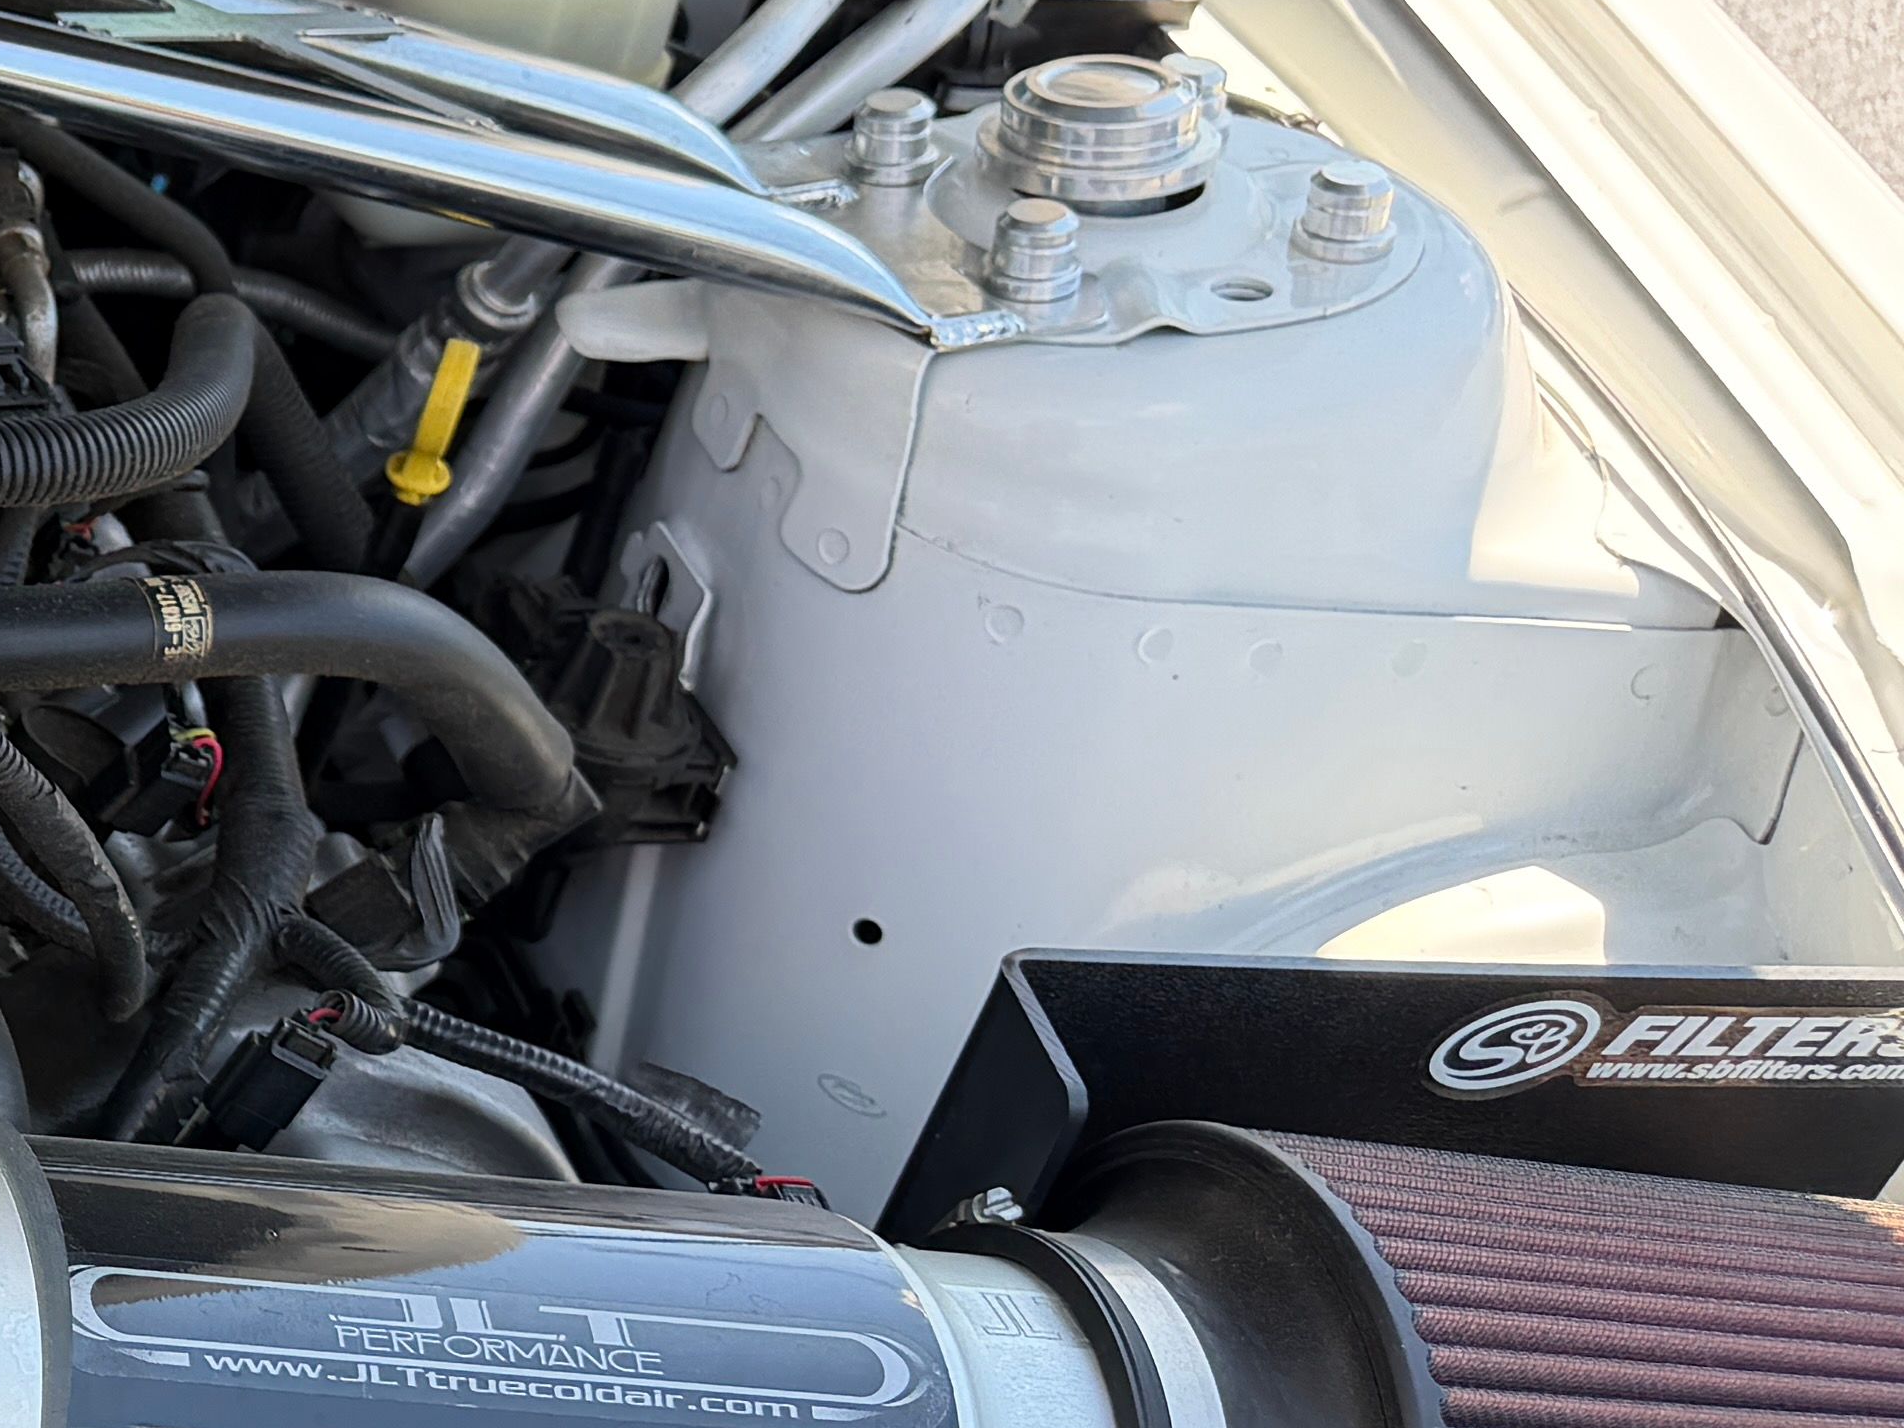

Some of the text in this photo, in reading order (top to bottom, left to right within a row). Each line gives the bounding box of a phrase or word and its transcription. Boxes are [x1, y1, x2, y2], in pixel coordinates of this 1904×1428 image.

[328, 1290, 634, 1349] JLT
[332, 1322, 665, 1376] PERFORMANCE
[203, 1352, 800, 1422] www.JLTtruecoldair.com
